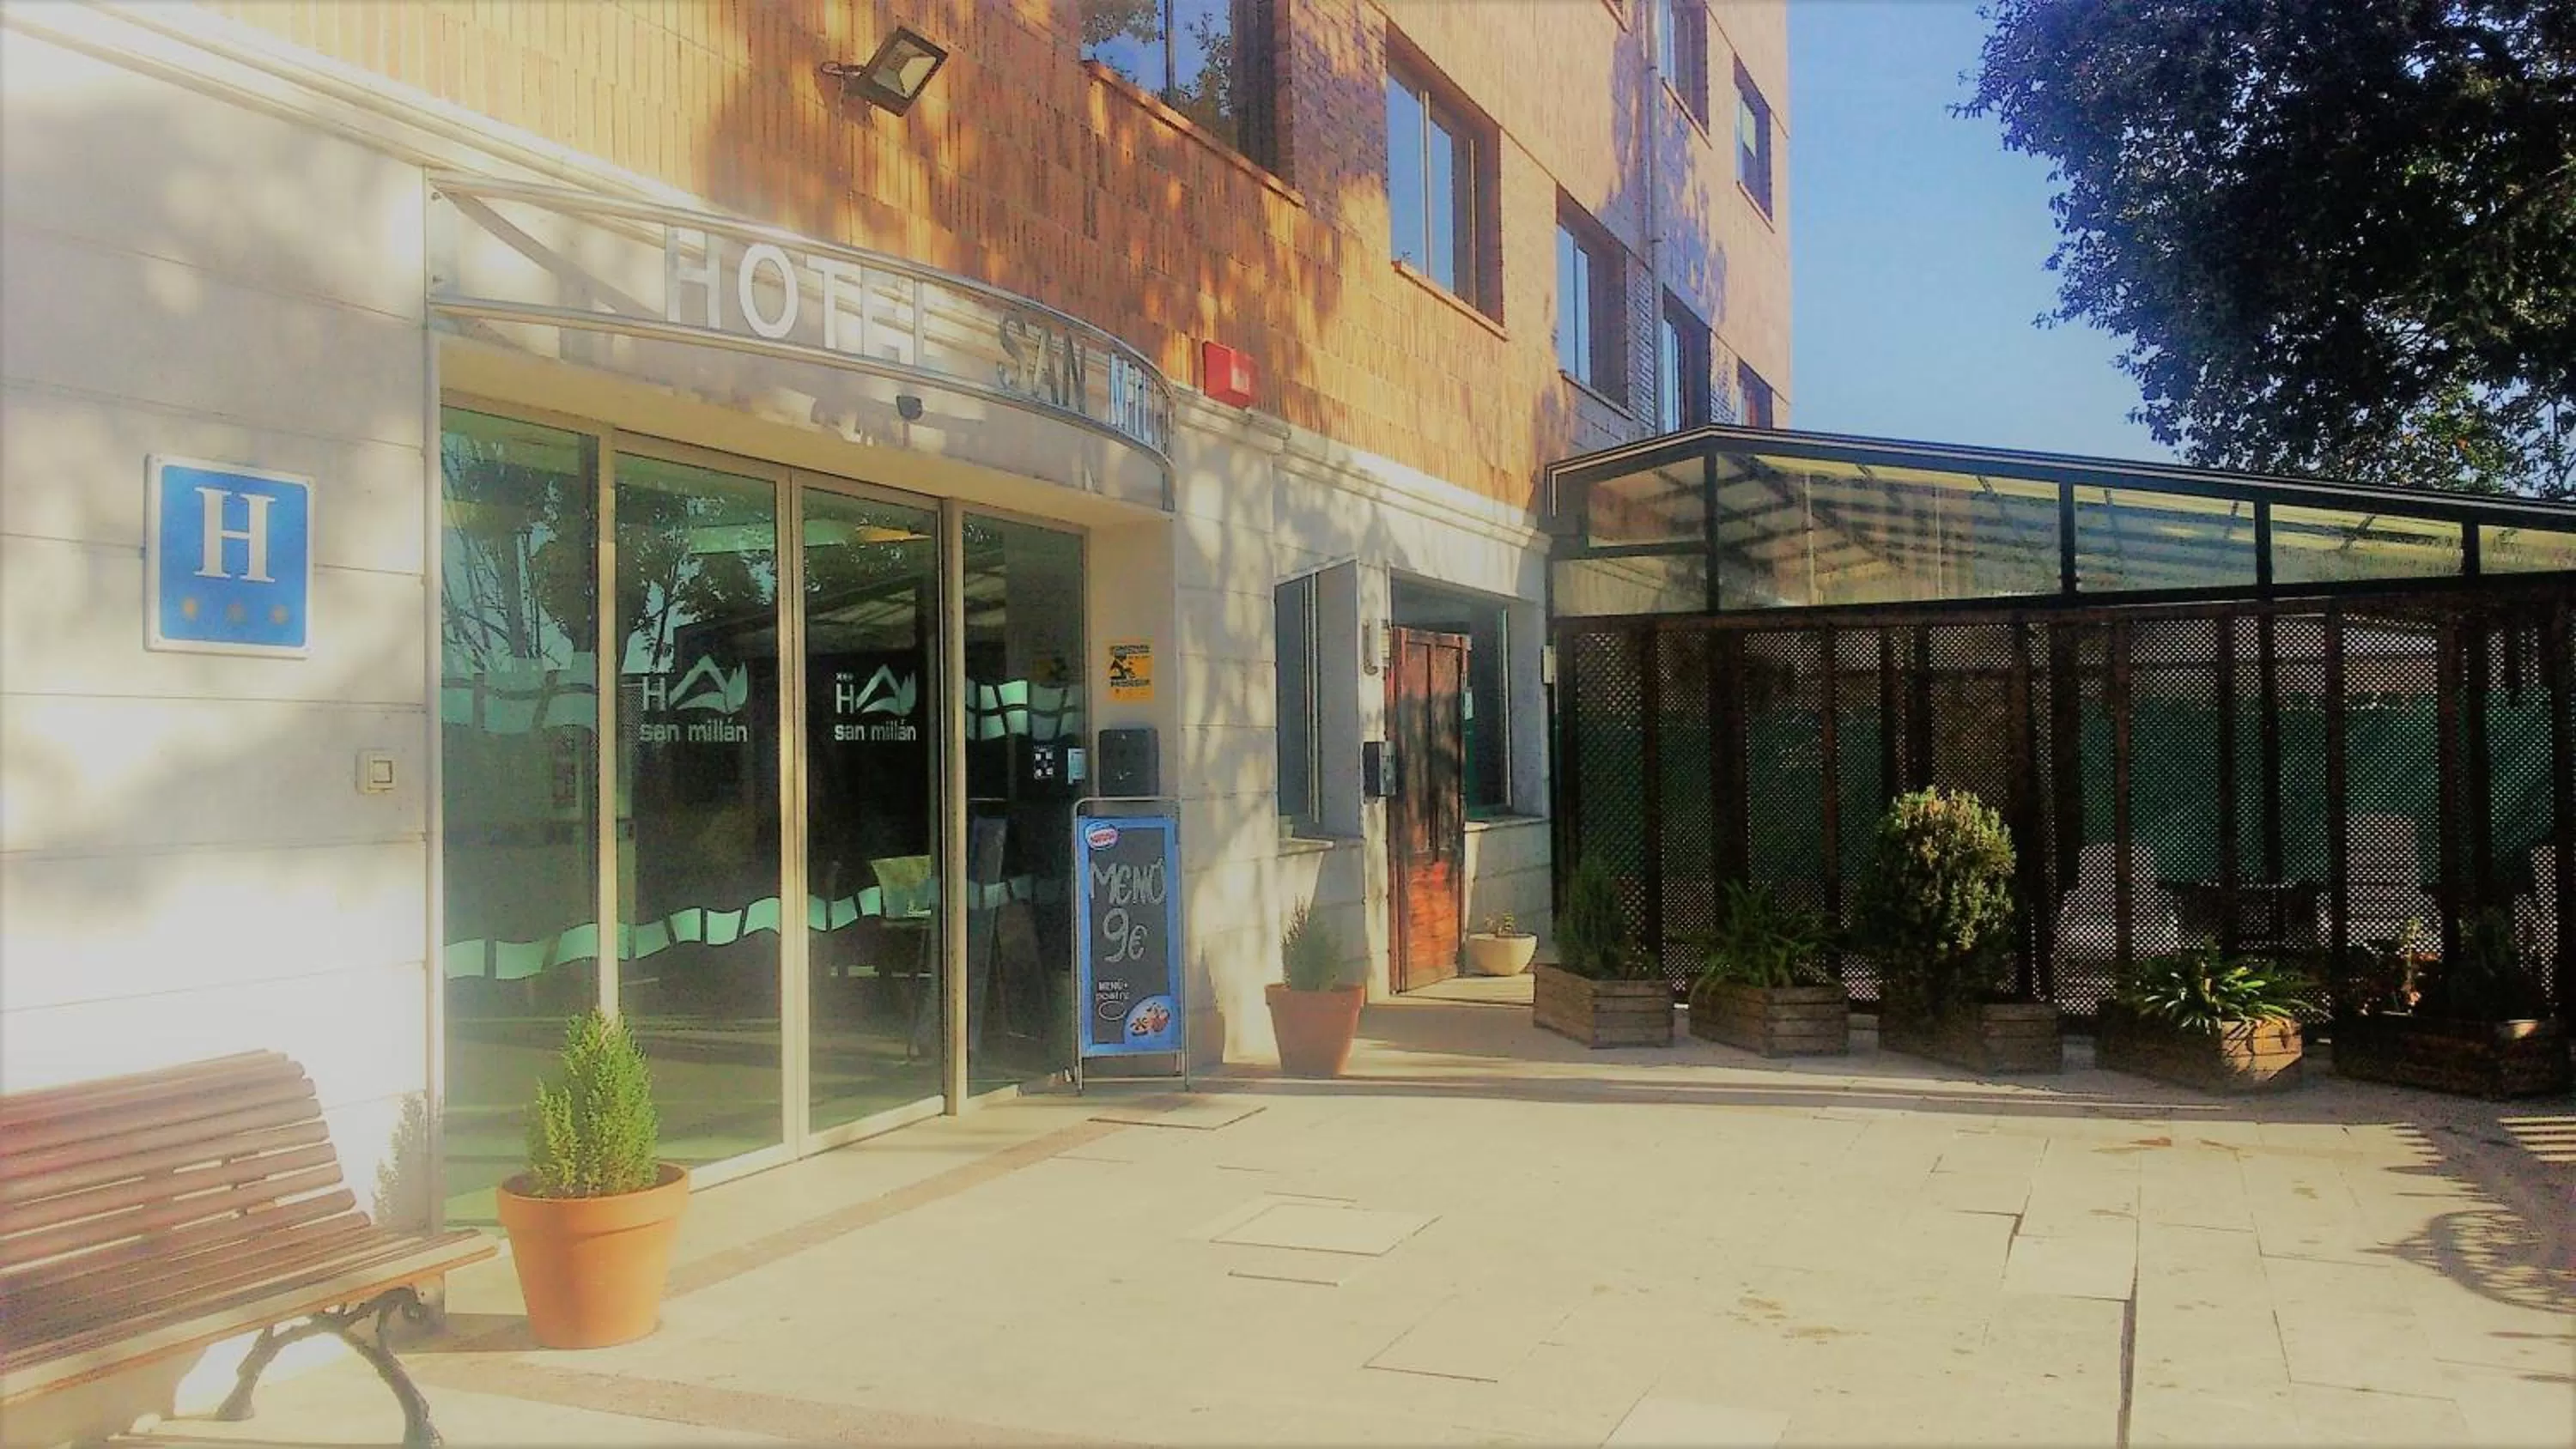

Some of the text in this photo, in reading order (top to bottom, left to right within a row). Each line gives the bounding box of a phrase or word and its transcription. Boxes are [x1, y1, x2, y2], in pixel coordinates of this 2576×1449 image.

[665, 223, 948, 378] HOTEL
[997, 309, 1086, 415] SAN
[194, 486, 276, 583] H
[641, 676, 666, 712] H
[835, 682, 854, 714] H
[639, 716, 748, 743] san millán
[835, 718, 916, 742] san millán
